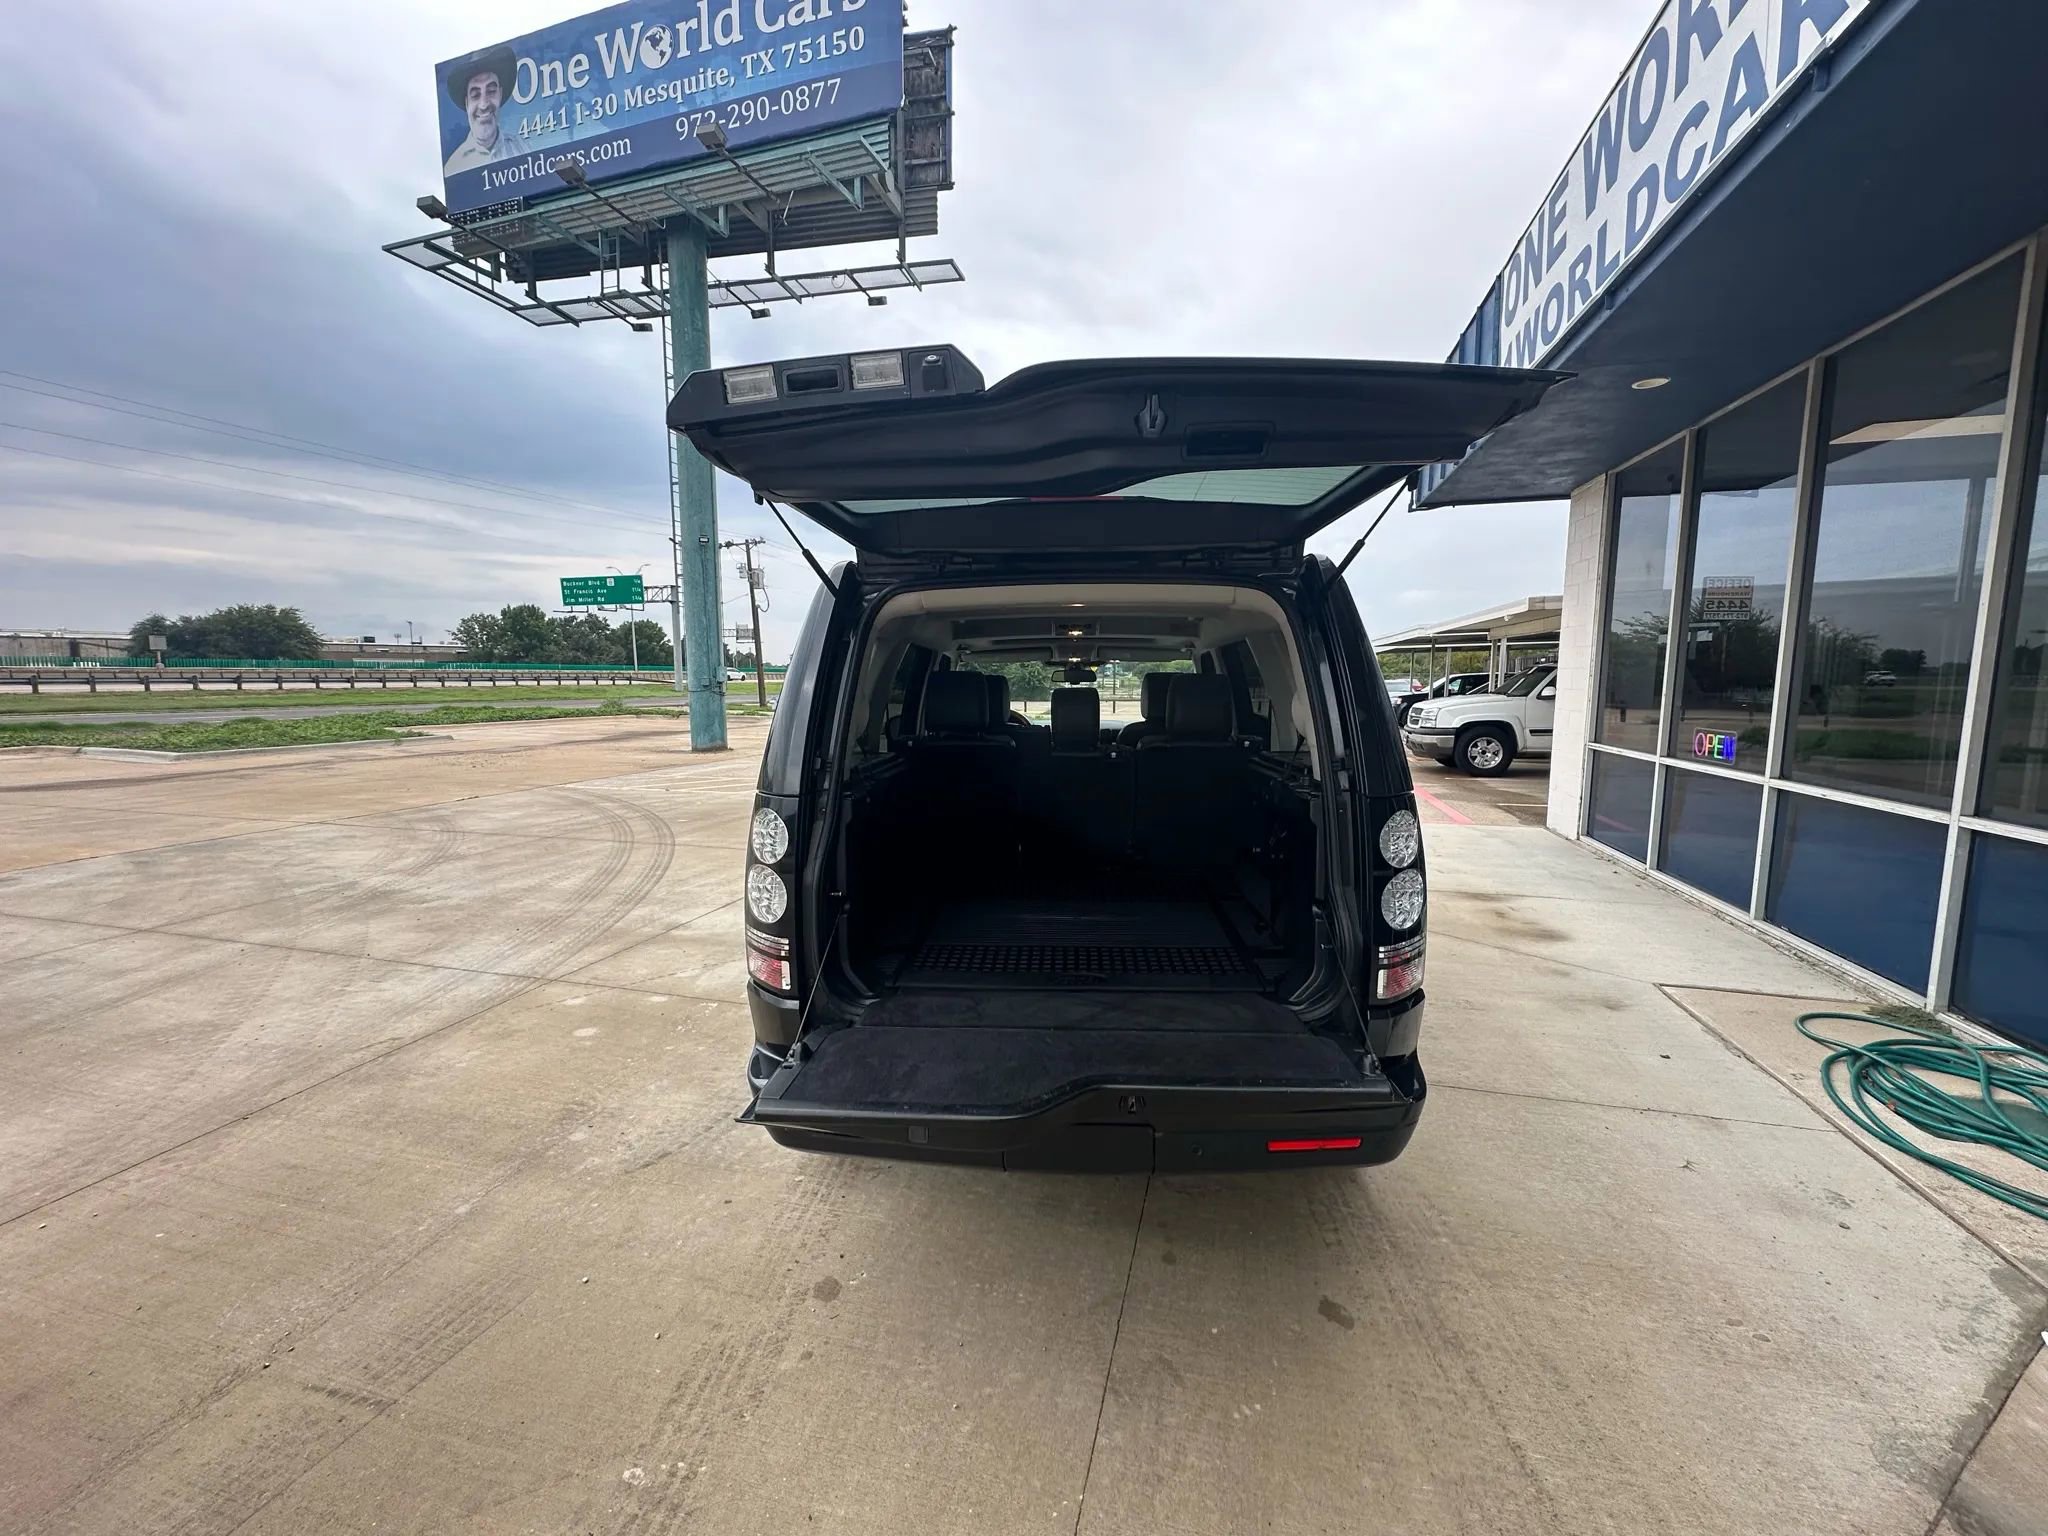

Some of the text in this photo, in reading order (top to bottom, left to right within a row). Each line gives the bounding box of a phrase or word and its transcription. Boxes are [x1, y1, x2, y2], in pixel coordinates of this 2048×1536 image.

[512, 0, 866, 105] One World Ca
[518, 26, 865, 139] 4441 I-30 Mesquite, TX 75150
[1505, 0, 1750, 328] ONE WOR
[1695, 732, 1736, 760] OPEN
